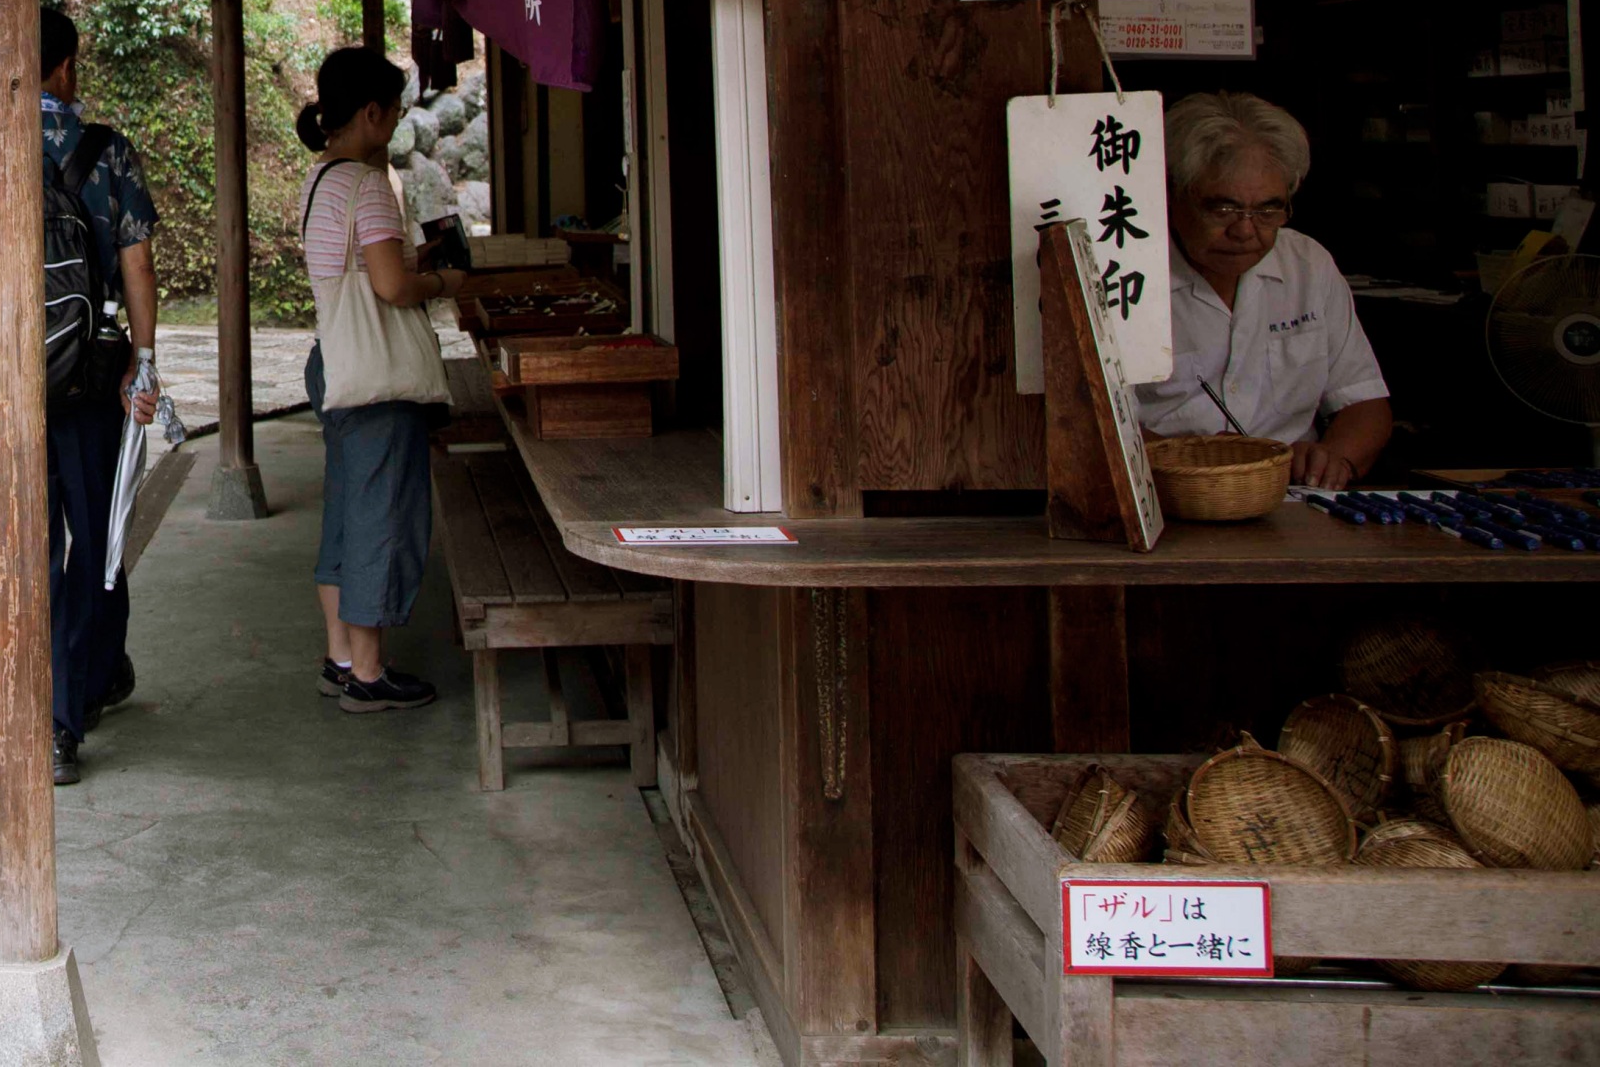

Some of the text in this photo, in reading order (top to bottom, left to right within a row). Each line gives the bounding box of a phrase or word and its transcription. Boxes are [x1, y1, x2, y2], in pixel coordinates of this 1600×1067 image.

[1125, 37, 1184, 50] 0120-55-0818
[1126, 23, 1182, 35] 0467-31-0101
[1088, 114, 1150, 322] 御朱印
[1082, 891, 1208, 923] 「ザル」は
[1084, 930, 1252, 962] 線香と一緒に
